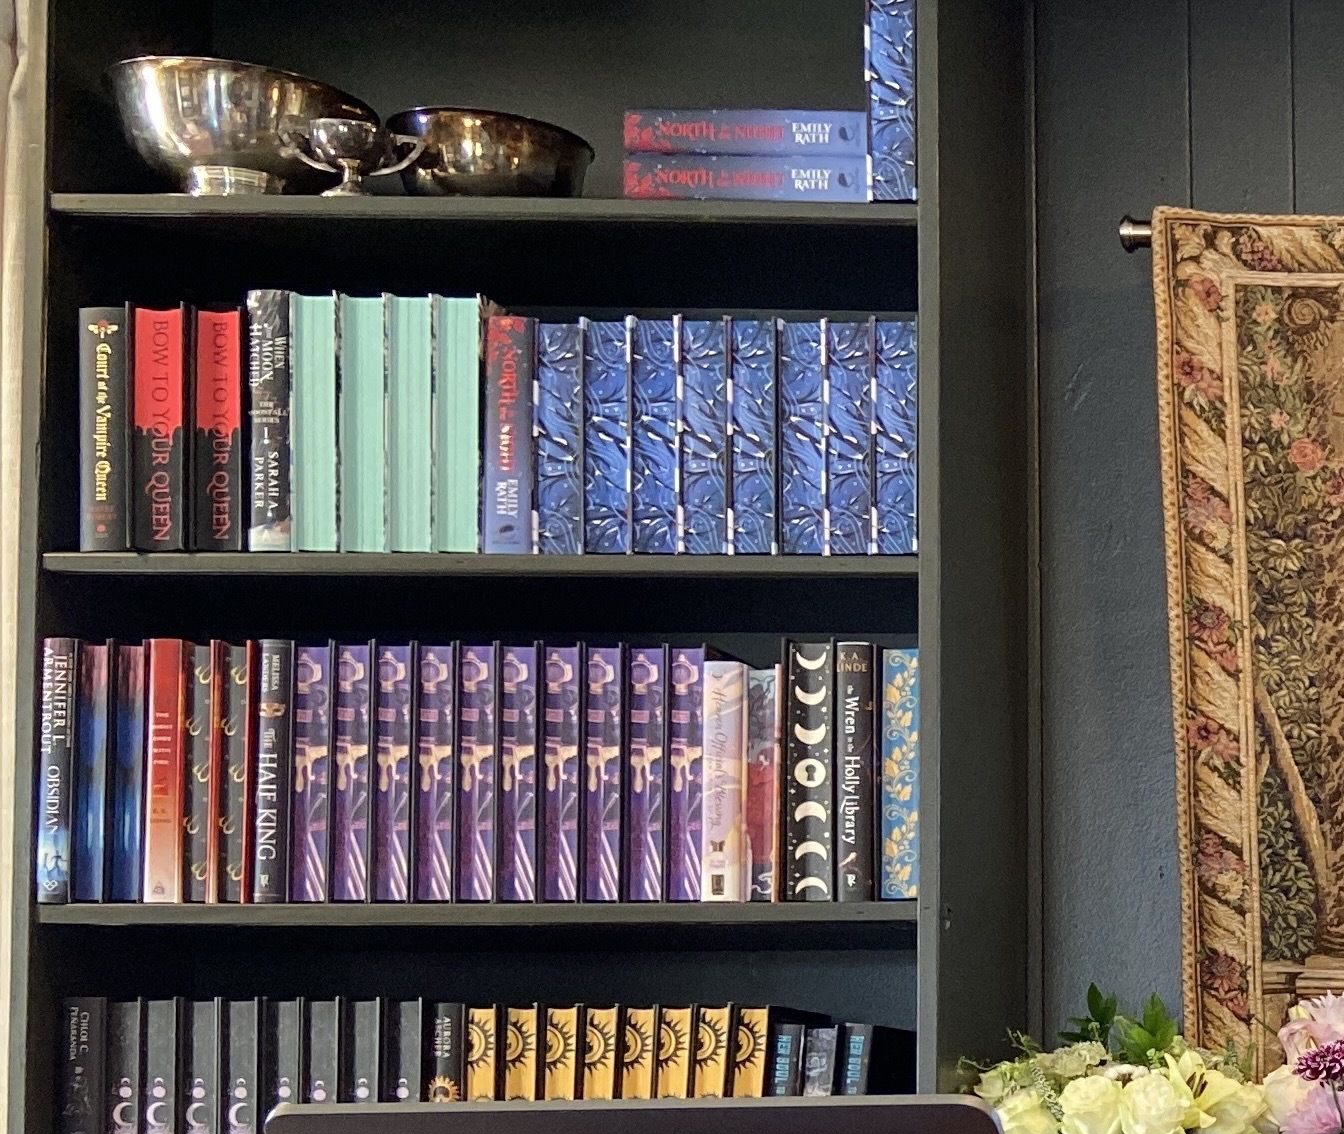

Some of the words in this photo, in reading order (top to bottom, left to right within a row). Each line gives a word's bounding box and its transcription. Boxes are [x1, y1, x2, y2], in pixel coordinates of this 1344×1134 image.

[791, 122, 833, 134] EMILY
[794, 133, 830, 145] RATH
[791, 168, 832, 180] EMILY
[794, 178, 829, 191] RATH
[95, 342, 112, 379] Court
[152, 320, 169, 366] BOW
[212, 322, 228, 367] BOW
[249, 322, 263, 387] HATCHED
[261, 340, 274, 381] MOON
[274, 335, 287, 370] WHEN
[151, 371, 169, 402] TO
[212, 376, 228, 403] TO
[499, 351, 518, 408] NORTH
[93, 404, 112, 458] Vampire
[151, 407, 172, 466] YOUR
[211, 407, 232, 465] YOUR
[94, 460, 112, 501] Queen
[254, 456, 265, 509] PARKER
[267, 450, 280, 497] SARAH
[145, 471, 172, 541] QUEEN
[206, 471, 231, 540] QUEEN
[496, 481, 508, 515] RATH
[506, 479, 519, 518] EMILY
[271, 654, 281, 691] MELISSA
[836, 662, 869, 673] LINDE
[40, 647, 55, 755] ARMENTROUT
[51, 655, 68, 727] JENNIFER
[844, 695, 860, 735] Wren
[263, 728, 277, 749] THE
[841, 755, 861, 794] Holly
[45, 765, 61, 833] OBSIDIAN
[257, 808, 277, 861] KING
[839, 795, 860, 845] Library
[442, 1015, 452, 1059] AURORA
[776, 1034, 793, 1056] HER
[774, 1056, 790, 1084] SOUL
